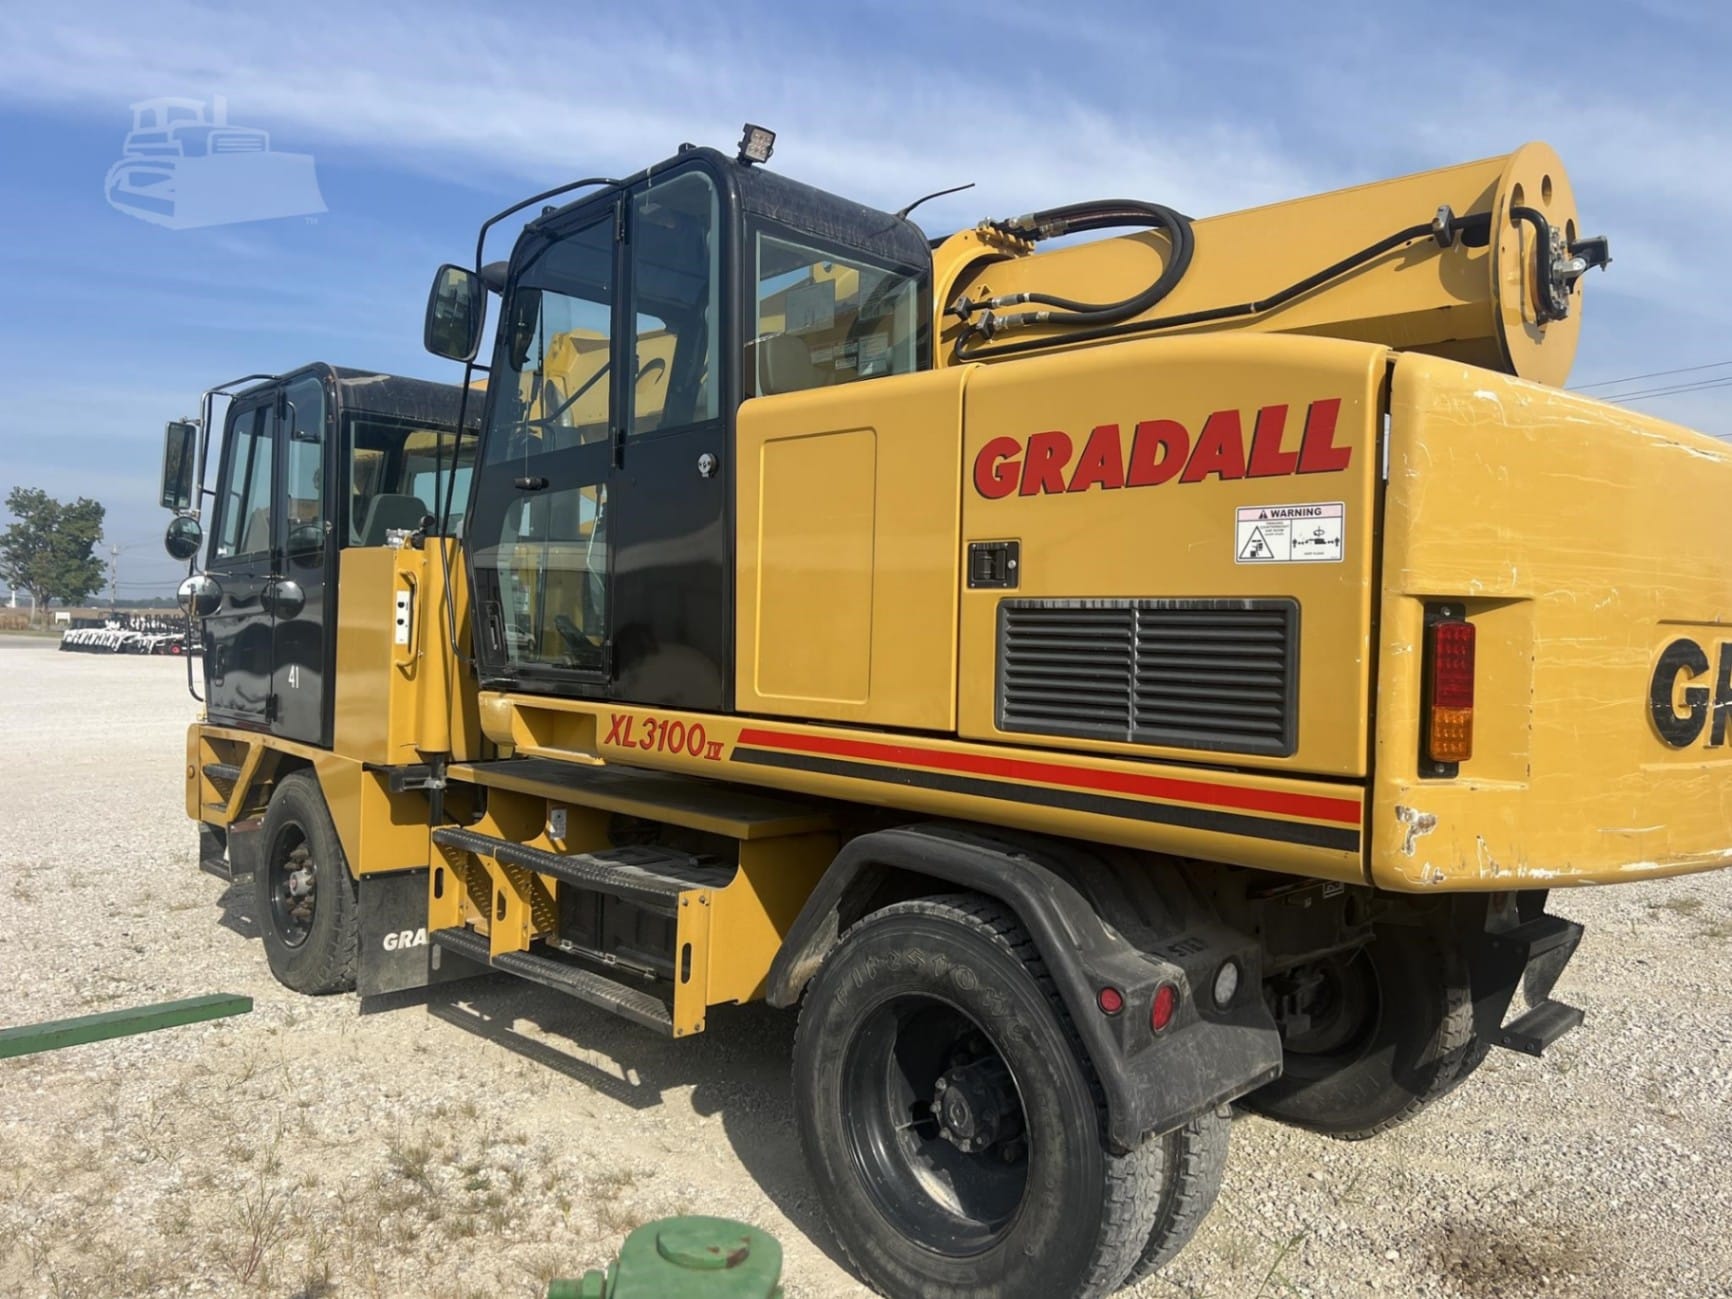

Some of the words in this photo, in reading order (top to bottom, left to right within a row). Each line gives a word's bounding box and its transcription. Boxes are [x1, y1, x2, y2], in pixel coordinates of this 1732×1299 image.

[973, 398, 1352, 500] GRADALL
[1270, 507, 1322, 518] WARNING
[604, 713, 706, 757] XL3100
